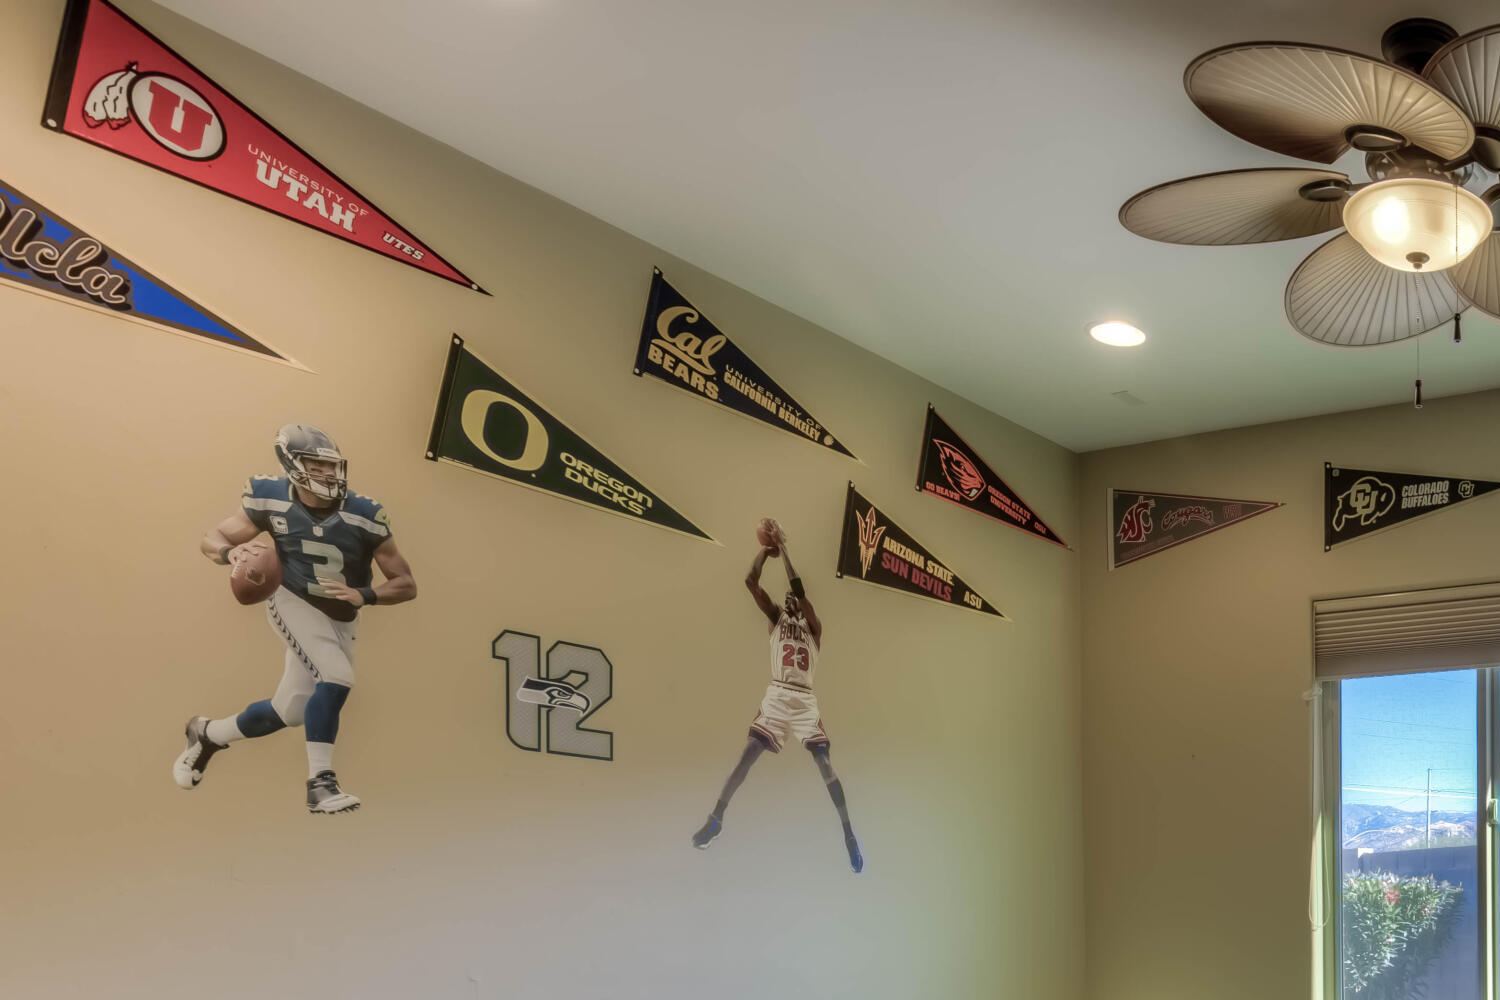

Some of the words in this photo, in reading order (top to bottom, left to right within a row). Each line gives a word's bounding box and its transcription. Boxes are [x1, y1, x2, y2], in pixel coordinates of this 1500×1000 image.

[148, 79, 213, 152] U
[248, 144, 344, 203] UNIVERSITY
[349, 202, 369, 216] OF
[256, 158, 356, 232] UTAH
[382, 231, 425, 260] UTES
[651, 305, 727, 376] Cal
[647, 343, 720, 401] BEARS
[725, 364, 802, 417] UNIVERSITY
[807, 418, 822, 431] OF
[461, 389, 549, 471] O
[723, 371, 777, 415] CALIFORNIA
[778, 406, 821, 441] BERKELEY
[559, 451, 653, 508] OREGON
[563, 467, 647, 516] DUCKS
[1401, 480, 1449, 498] COLORADO
[1401, 492, 1449, 509] BUFFALOES
[1012, 500, 1031, 519] STATE
[301, 539, 348, 599] 3
[881, 552, 909, 579] SUN
[911, 567, 952, 602] DEVILS
[883, 536, 925, 569] ARIZONA
[926, 560, 955, 586] STATE
[963, 591, 983, 609] ASU
[782, 643, 809, 672] 23
[492, 629, 613, 761] 12
